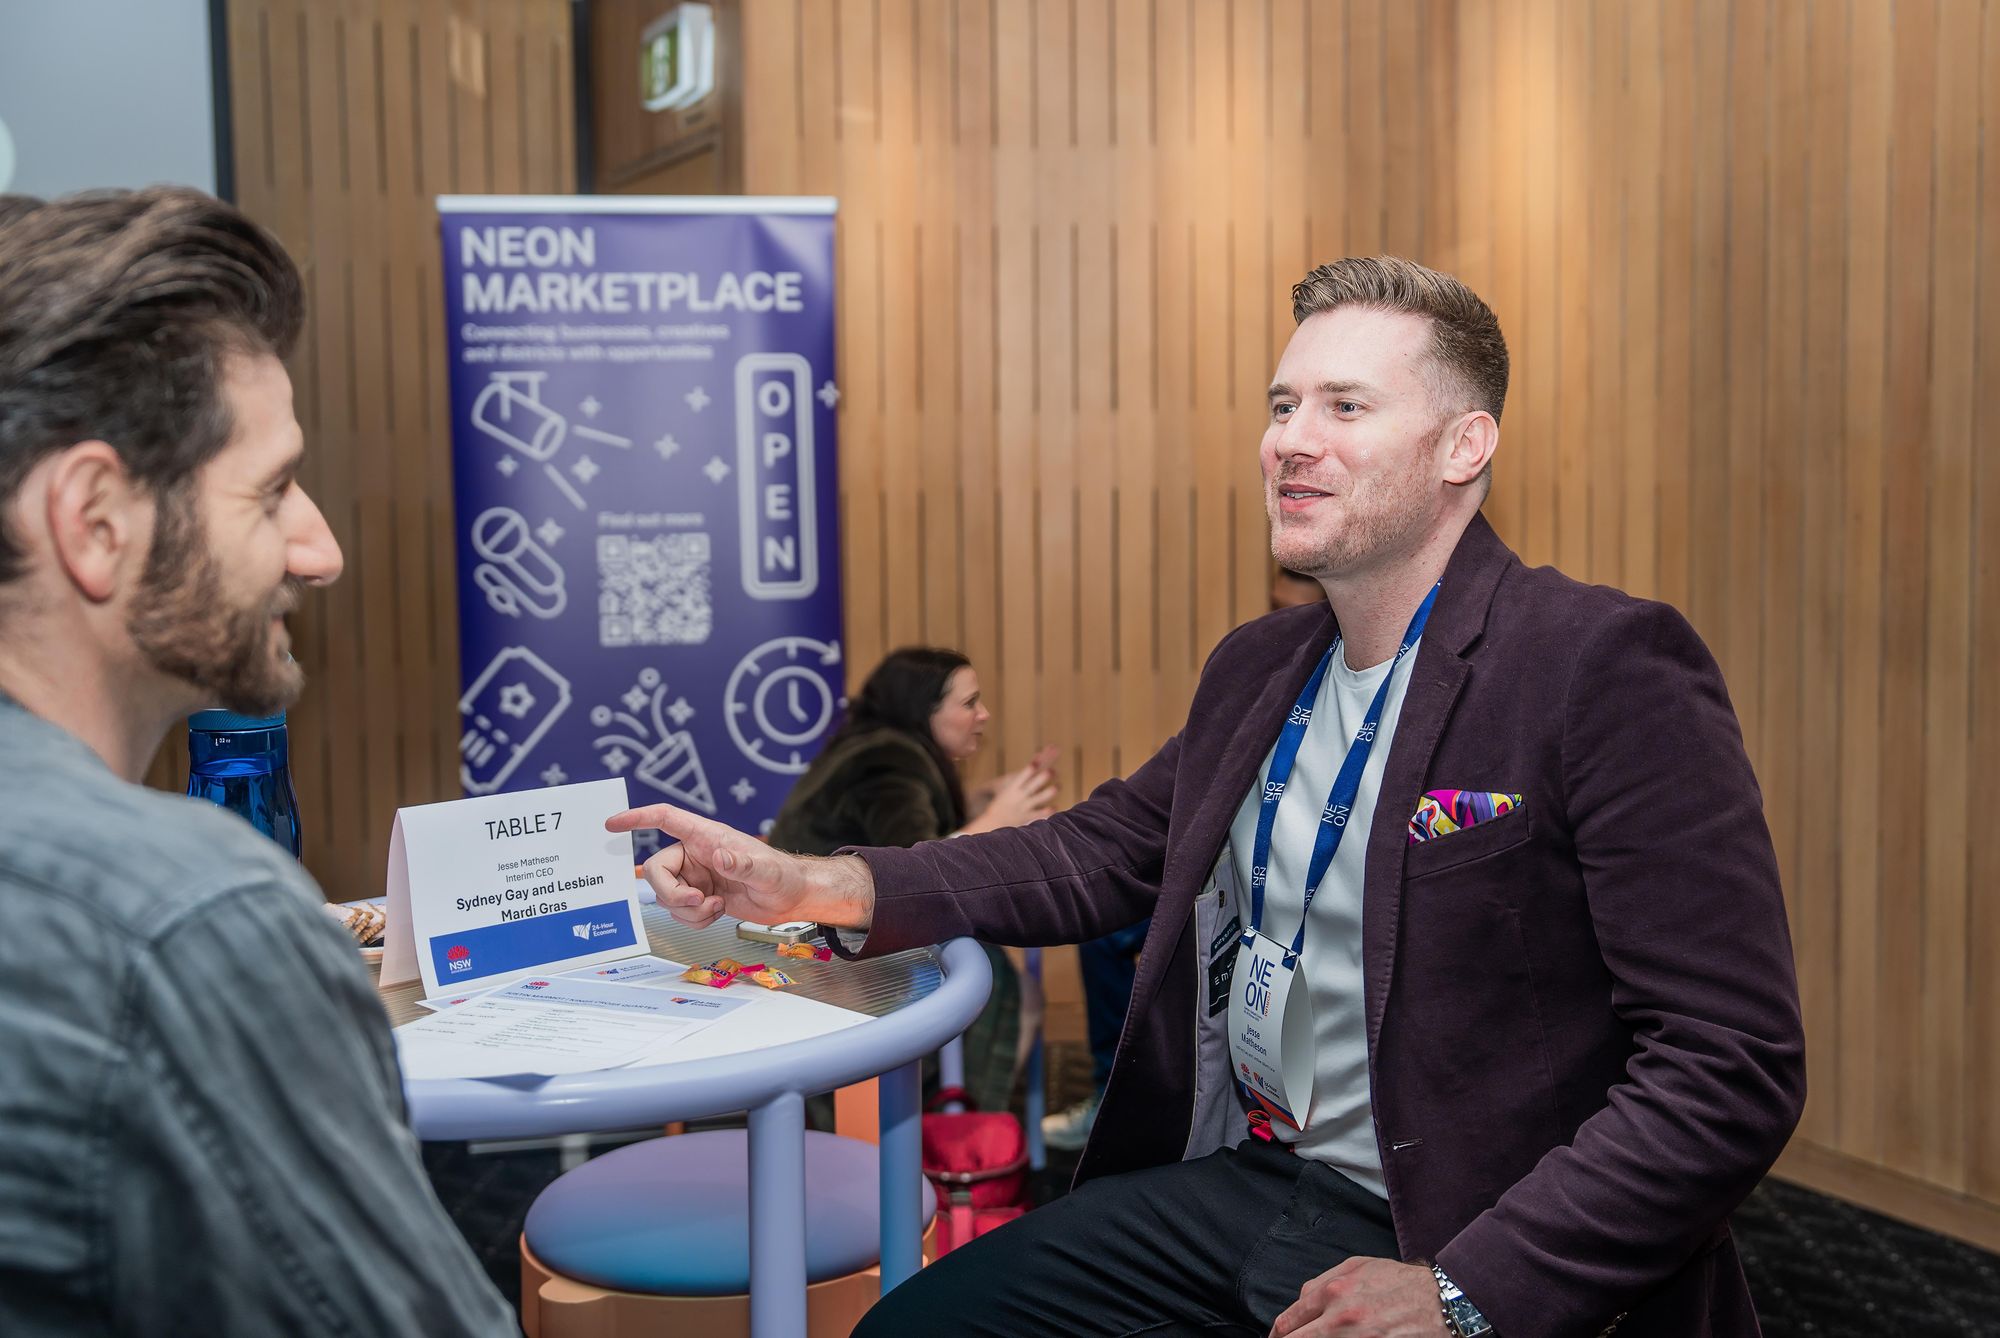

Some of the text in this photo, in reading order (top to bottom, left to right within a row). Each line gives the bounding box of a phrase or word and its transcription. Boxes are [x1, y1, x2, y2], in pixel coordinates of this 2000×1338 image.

[460, 226, 595, 267] NEON
[462, 272, 803, 313] MARKETPLACE
[463, 346, 495, 362] and
[570, 345, 602, 361] with
[758, 380, 796, 572] OPEN
[485, 811, 563, 841] TABLE 7
[497, 853, 560, 871] Jesse Matheson
[505, 867, 554, 883] Interim CEO
[456, 874, 604, 912] Sydney Gay and Lesbian
[501, 900, 568, 922] Mardi Gras
[591, 922, 614, 931] 24-Hour
[593, 928, 618, 937] Economy
[449, 958, 472, 970] NSW
[1249, 954, 1276, 989] NE
[1245, 981, 1267, 1016] ON
[1246, 1024, 1262, 1040] Jesse
[1241, 1033, 1268, 1057] Matheson
